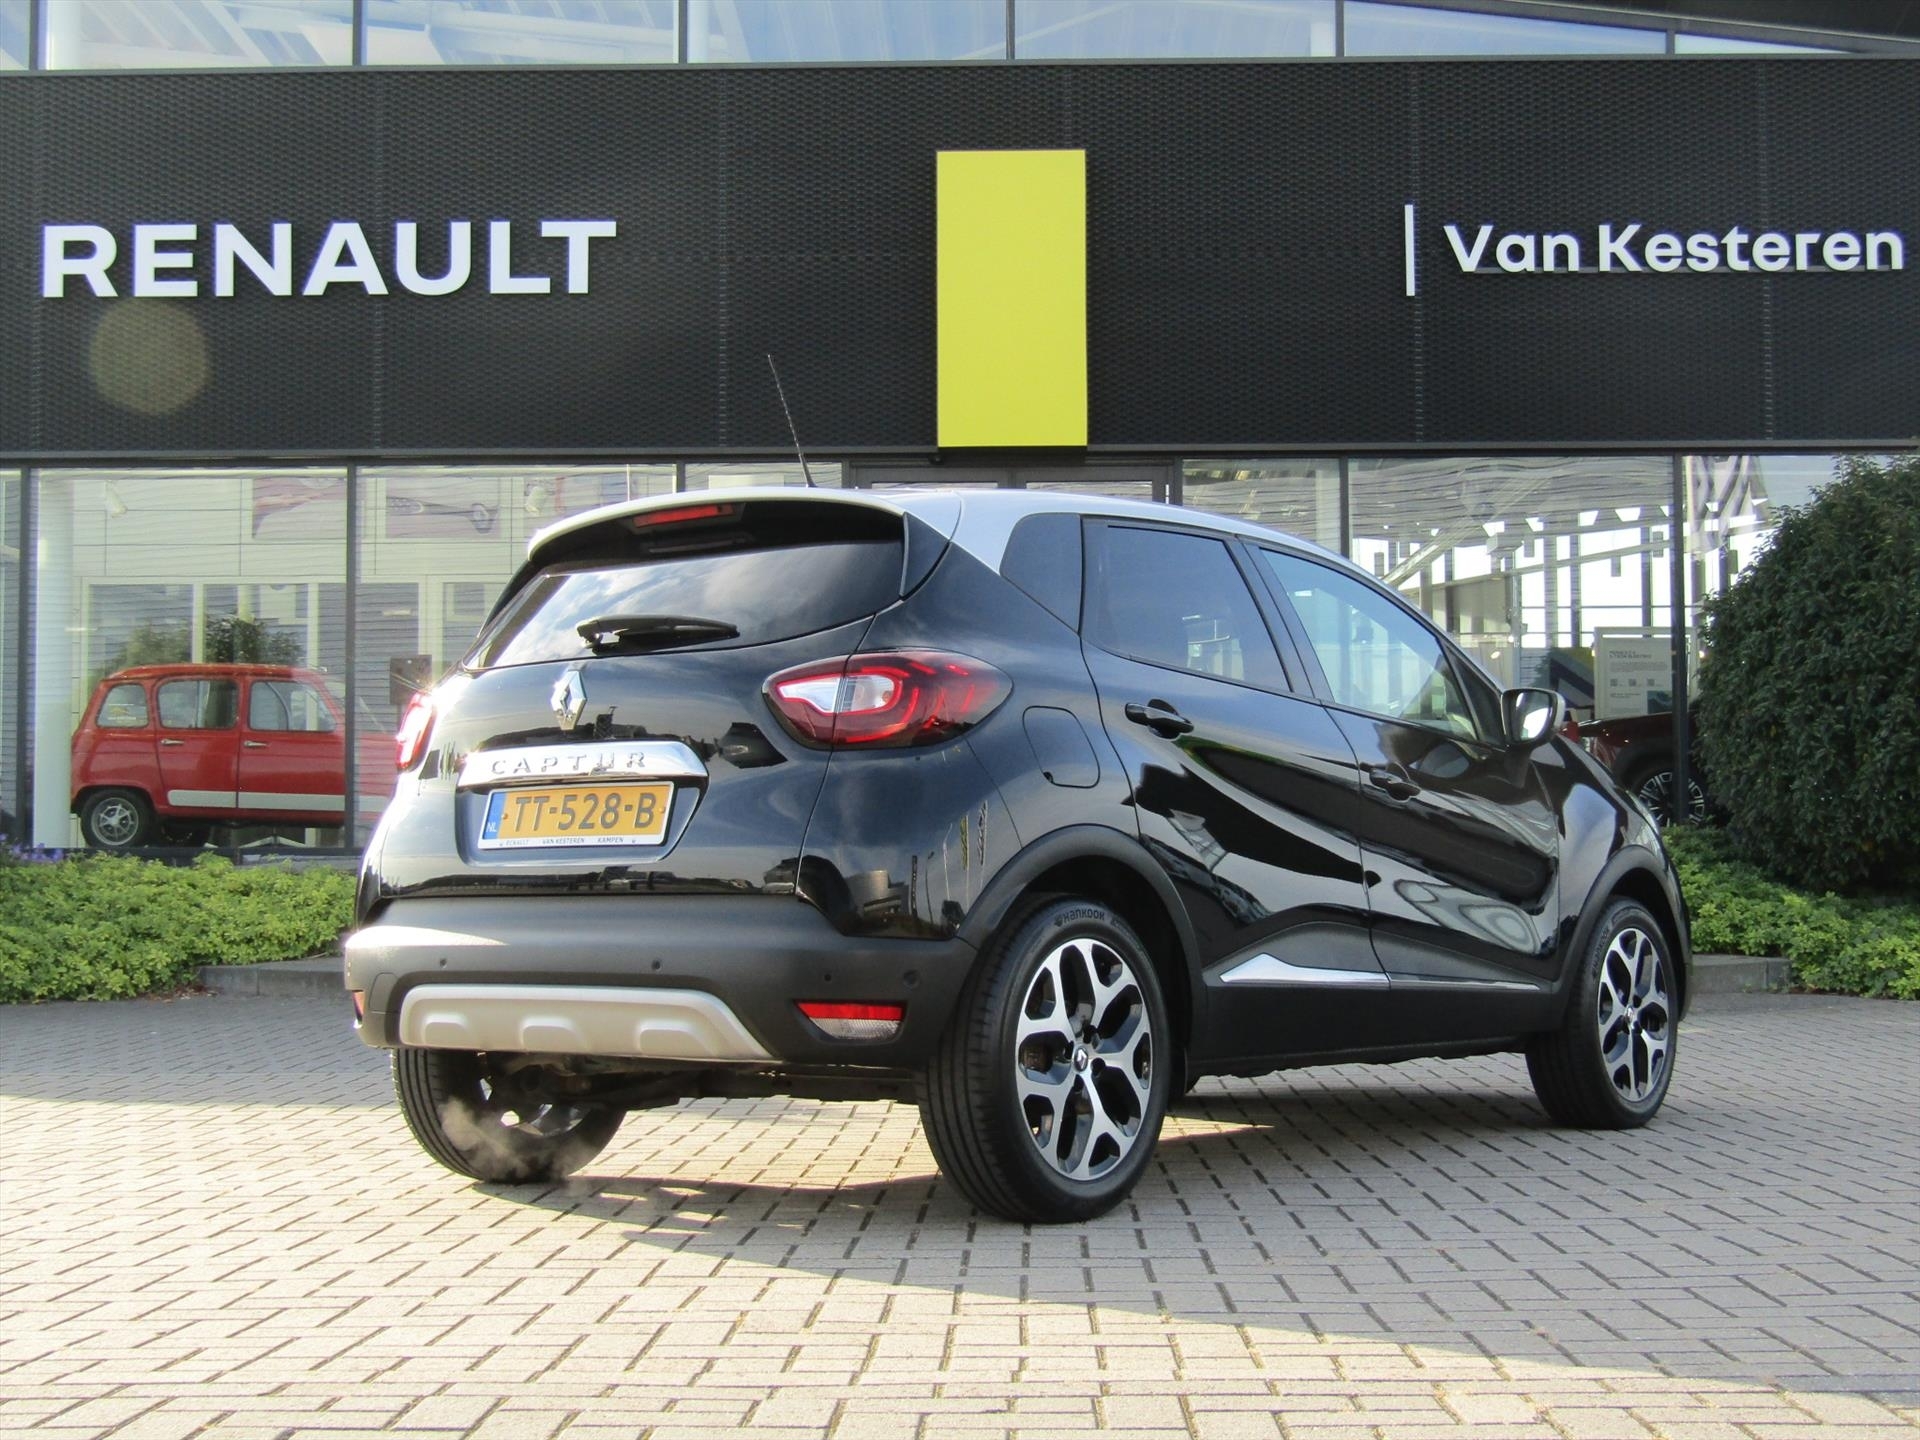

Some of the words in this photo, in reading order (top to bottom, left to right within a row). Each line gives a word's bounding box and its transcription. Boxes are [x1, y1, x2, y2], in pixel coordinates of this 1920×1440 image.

[42, 220, 617, 298] RENAULT
[1443, 225, 1580, 273] Van
[1598, 224, 1904, 273] Kesteren
[491, 751, 646, 774] CAPTUR
[486, 821, 498, 833] NL
[515, 792, 656, 832] TT-528-B
[597, 836, 624, 844] KAMPEN
